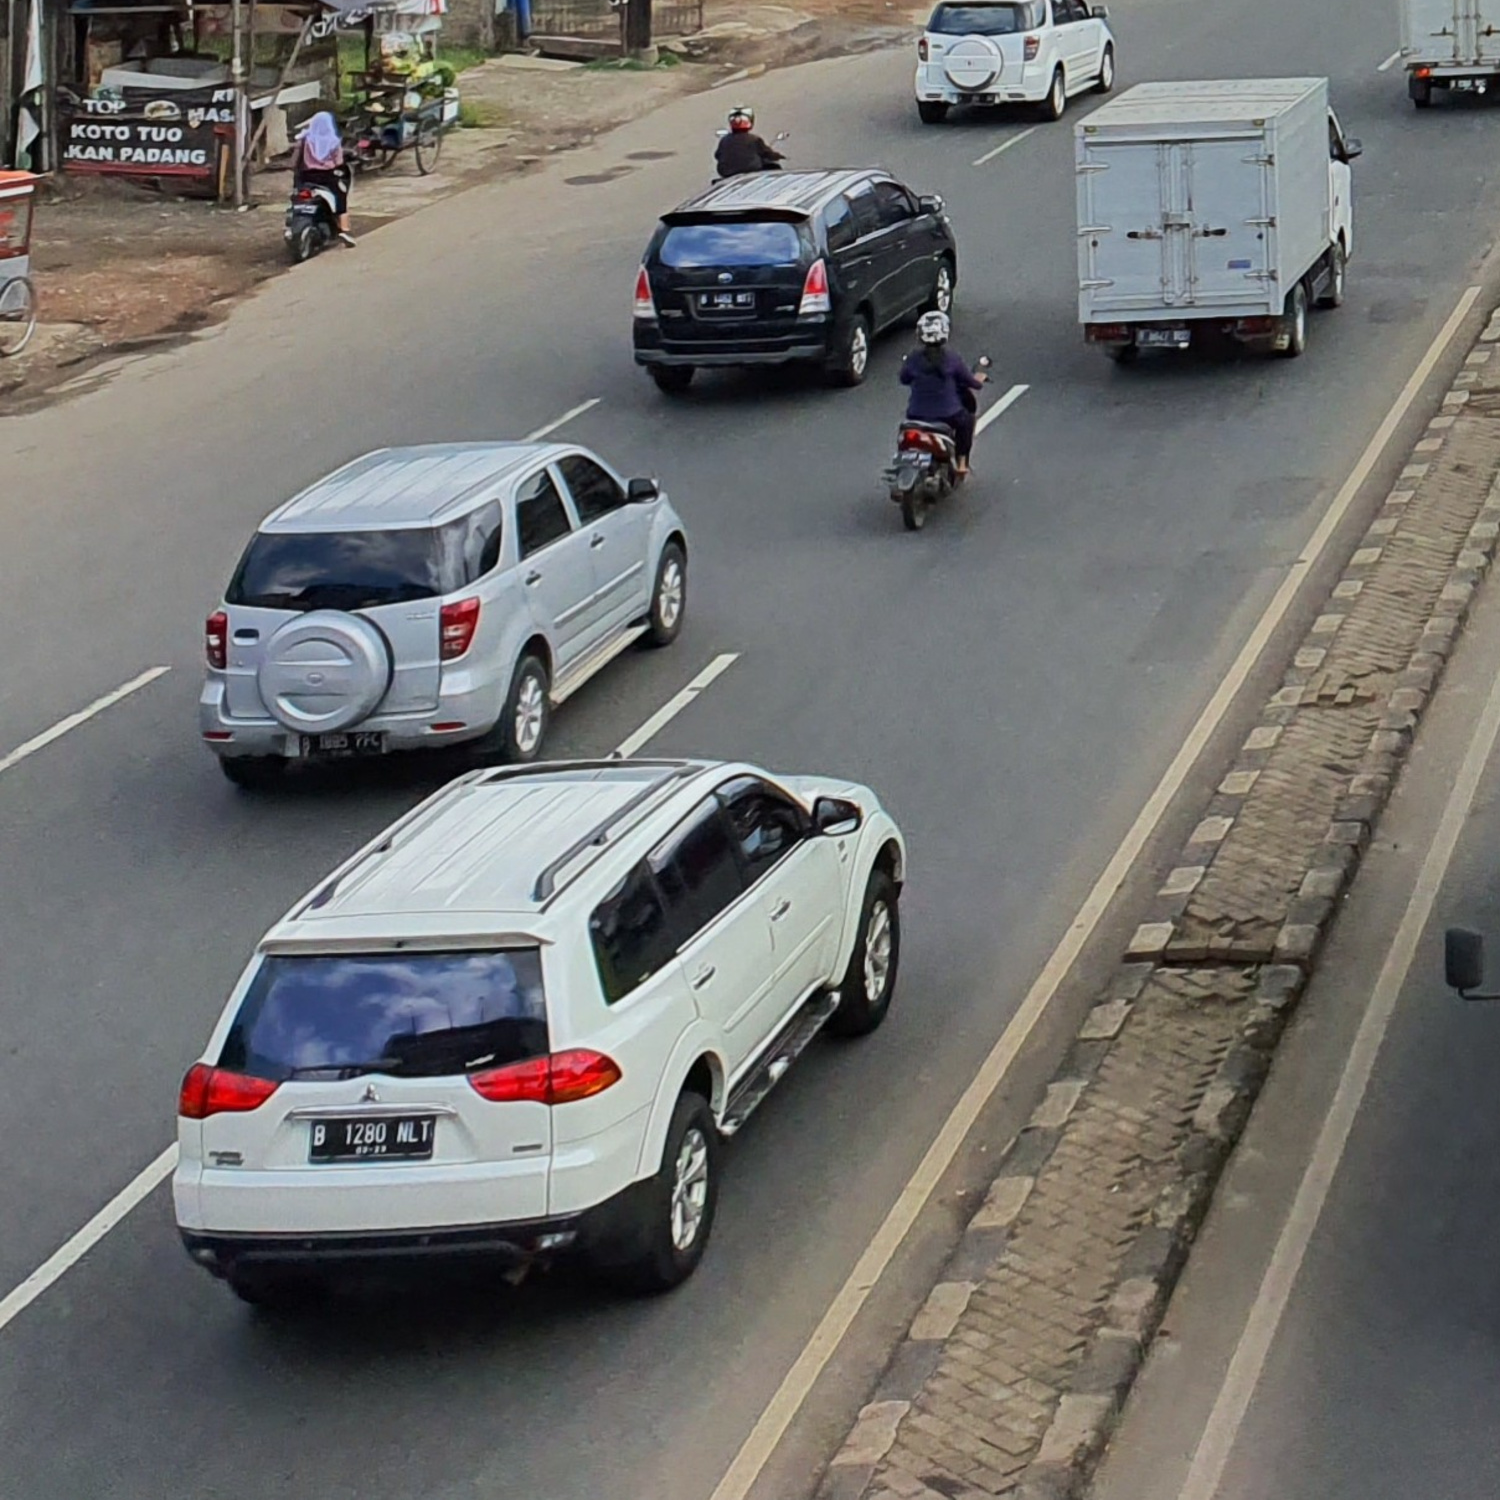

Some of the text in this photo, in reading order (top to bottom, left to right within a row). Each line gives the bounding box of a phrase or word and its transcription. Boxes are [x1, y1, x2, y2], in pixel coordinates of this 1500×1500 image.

[71, 124, 183, 142] KOTO TUO
[64, 145, 206, 164] KAN PADANG
[313, 1120, 432, 1146] B 1280 NLT
